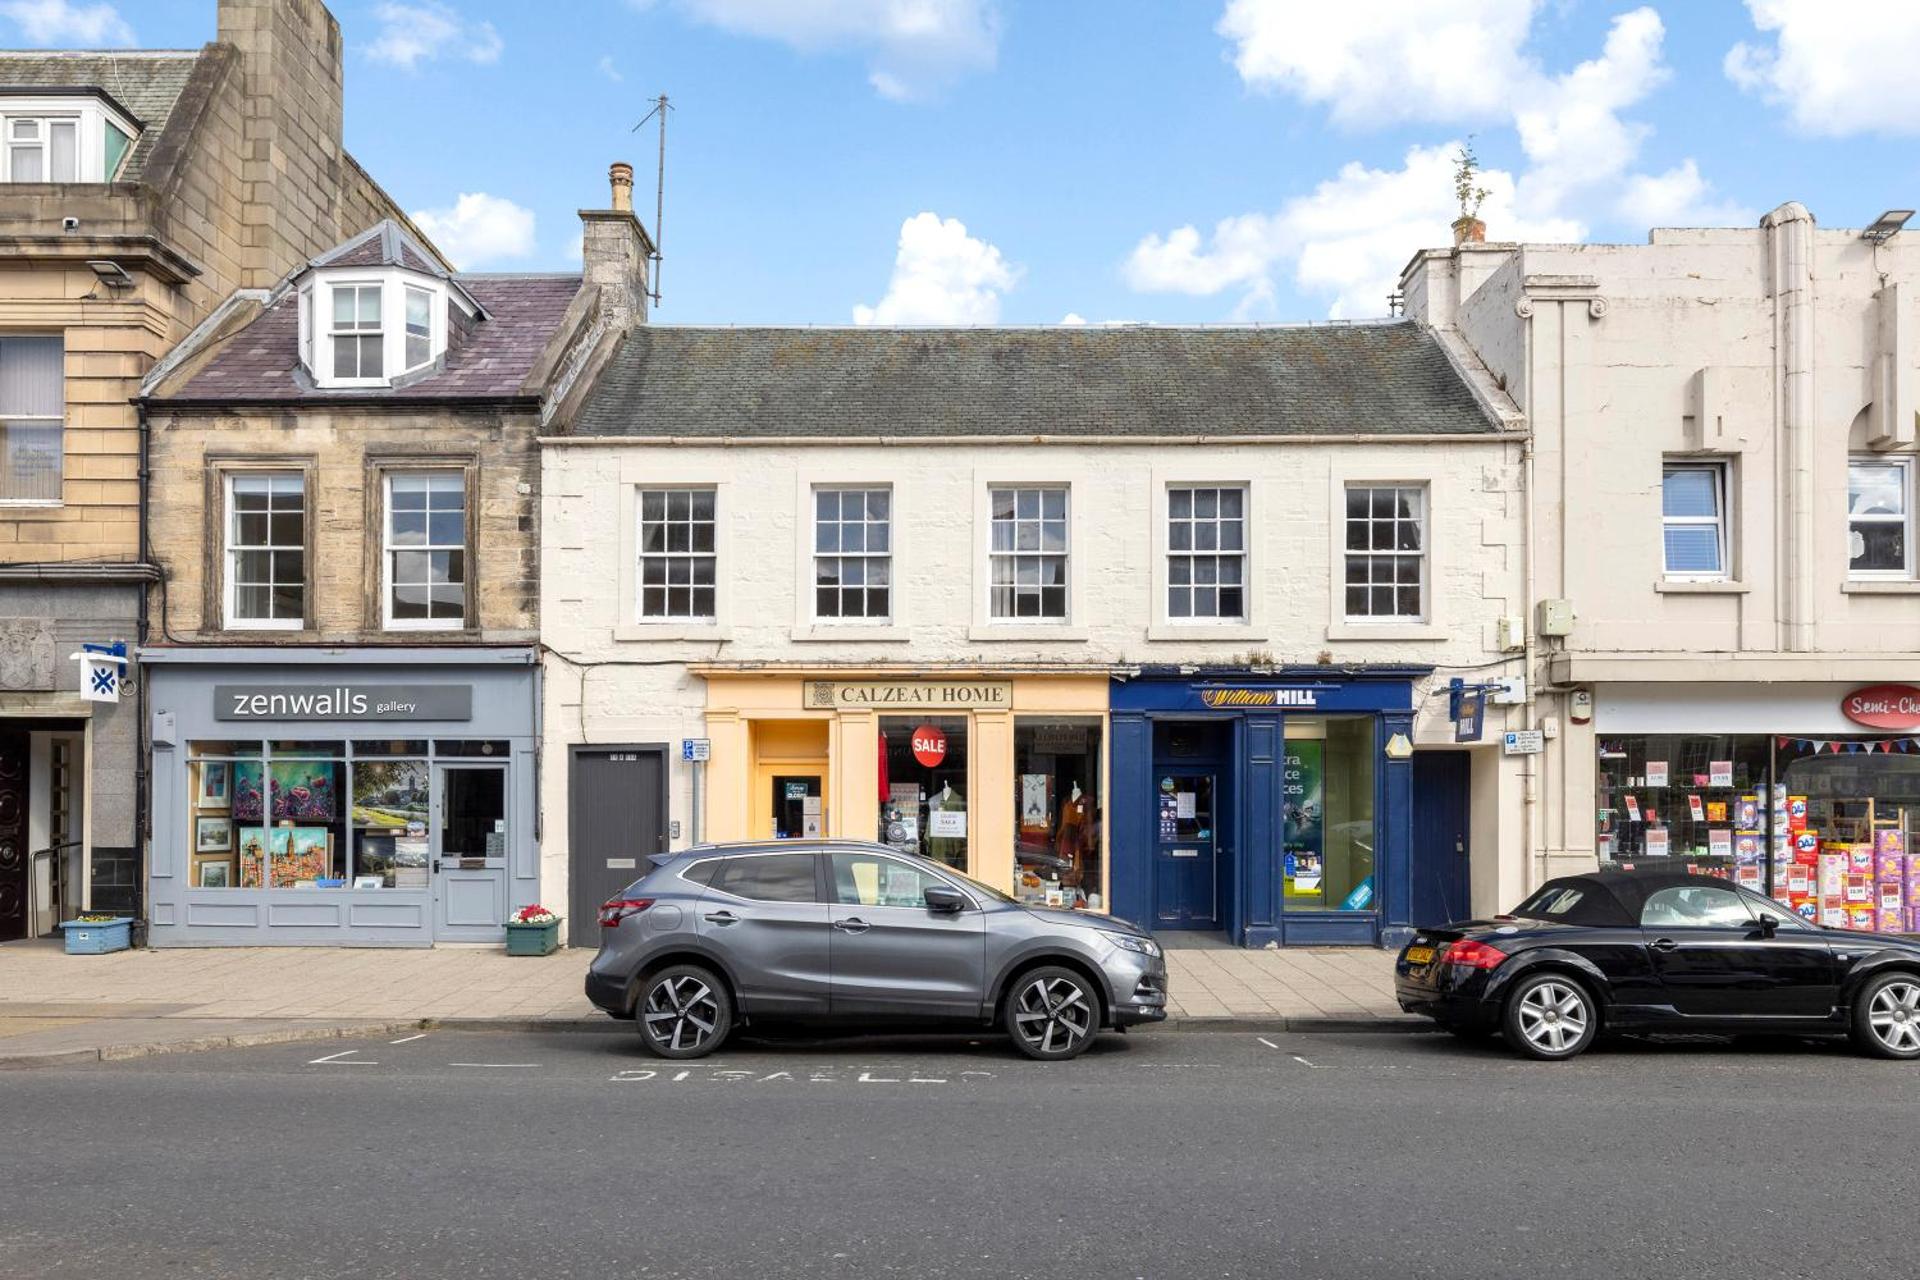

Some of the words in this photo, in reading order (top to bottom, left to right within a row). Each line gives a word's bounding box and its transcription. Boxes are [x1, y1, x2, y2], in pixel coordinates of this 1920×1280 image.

[233, 688, 368, 715] zenwalls
[376, 702, 416, 713] gallery
[841, 687, 936, 703] CALZEAT
[942, 687, 1003, 703] HOME
[1202, 689, 1276, 706] William
[1276, 690, 1317, 705] HILL
[914, 738, 945, 753] SALE
[1507, 735, 1515, 743] P
[1797, 837, 1816, 849] DAZ
